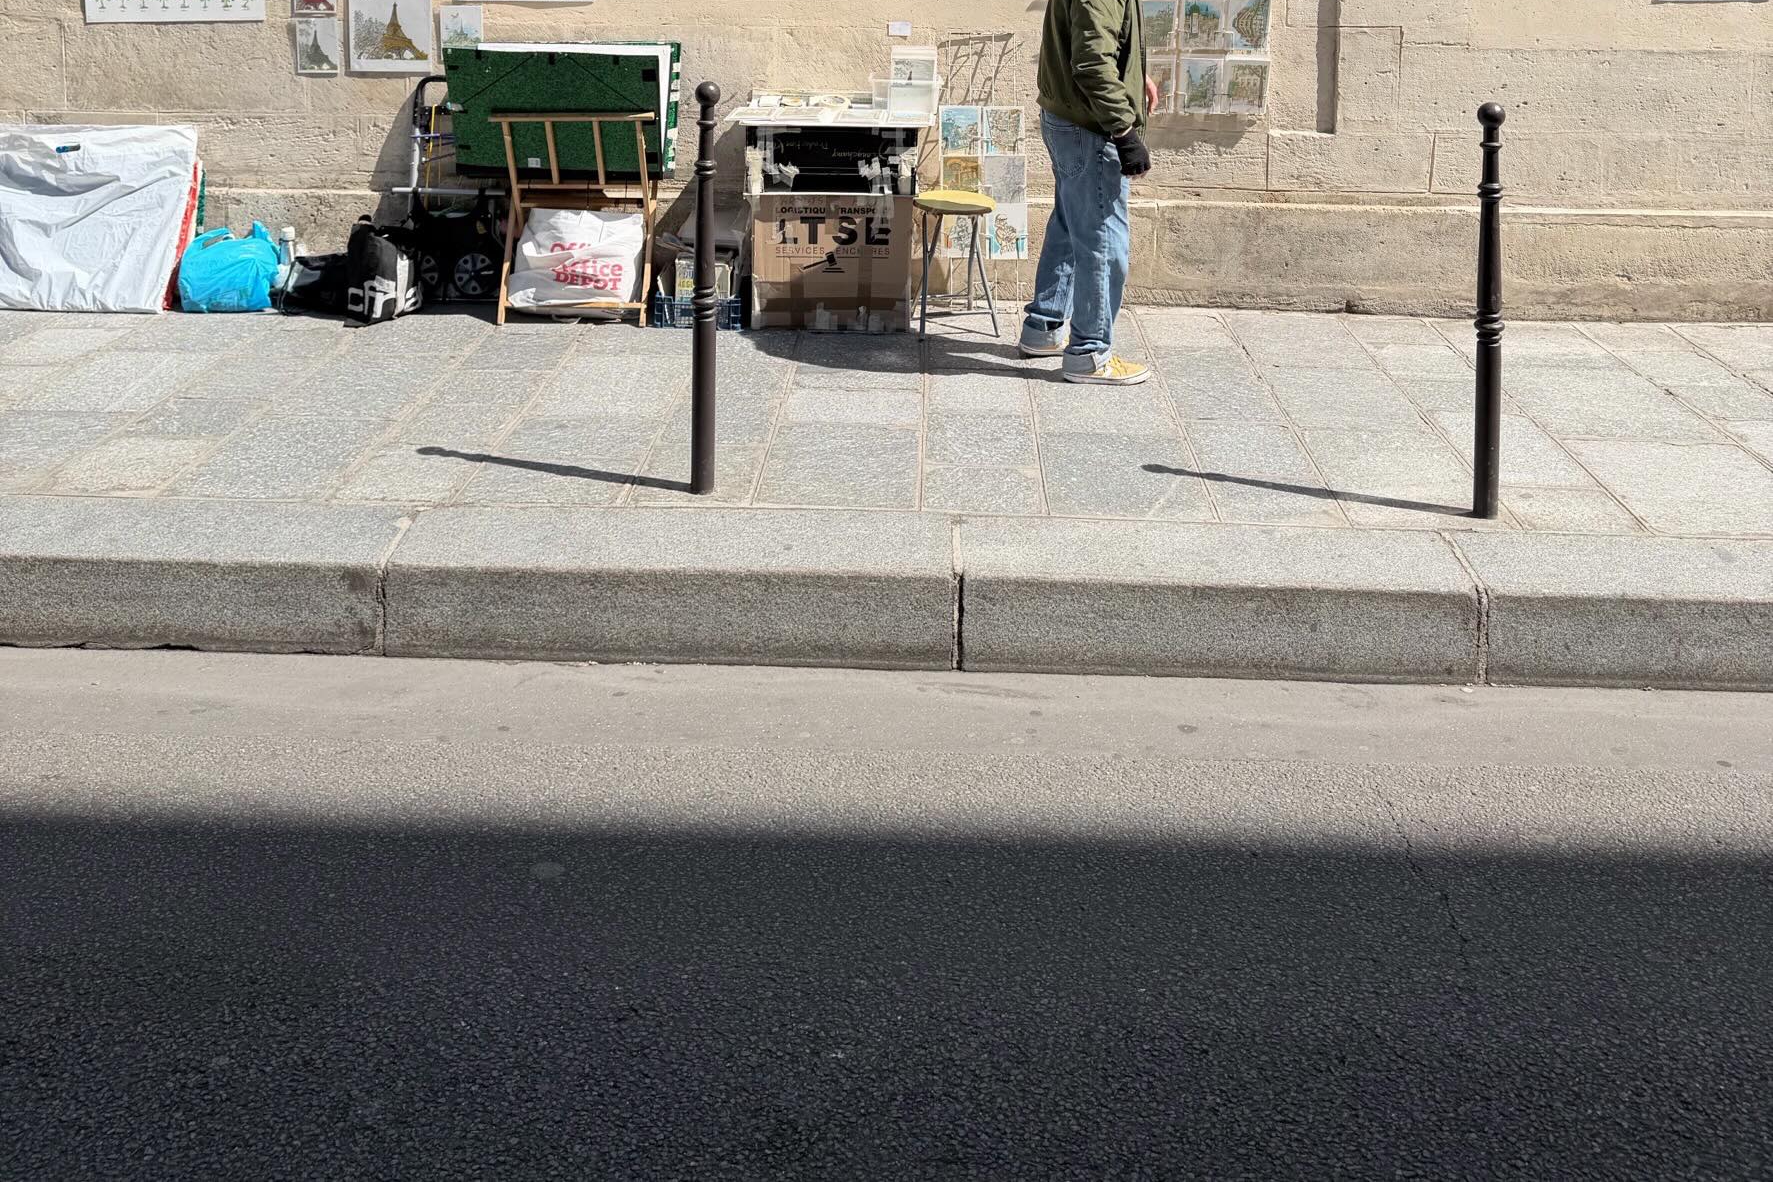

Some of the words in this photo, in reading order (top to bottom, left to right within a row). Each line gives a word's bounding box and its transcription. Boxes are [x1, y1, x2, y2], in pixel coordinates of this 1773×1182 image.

[776, 207, 826, 215] LOGISTIQU
[776, 216, 891, 245] LTSE
[836, 247, 890, 255] ENCRES
